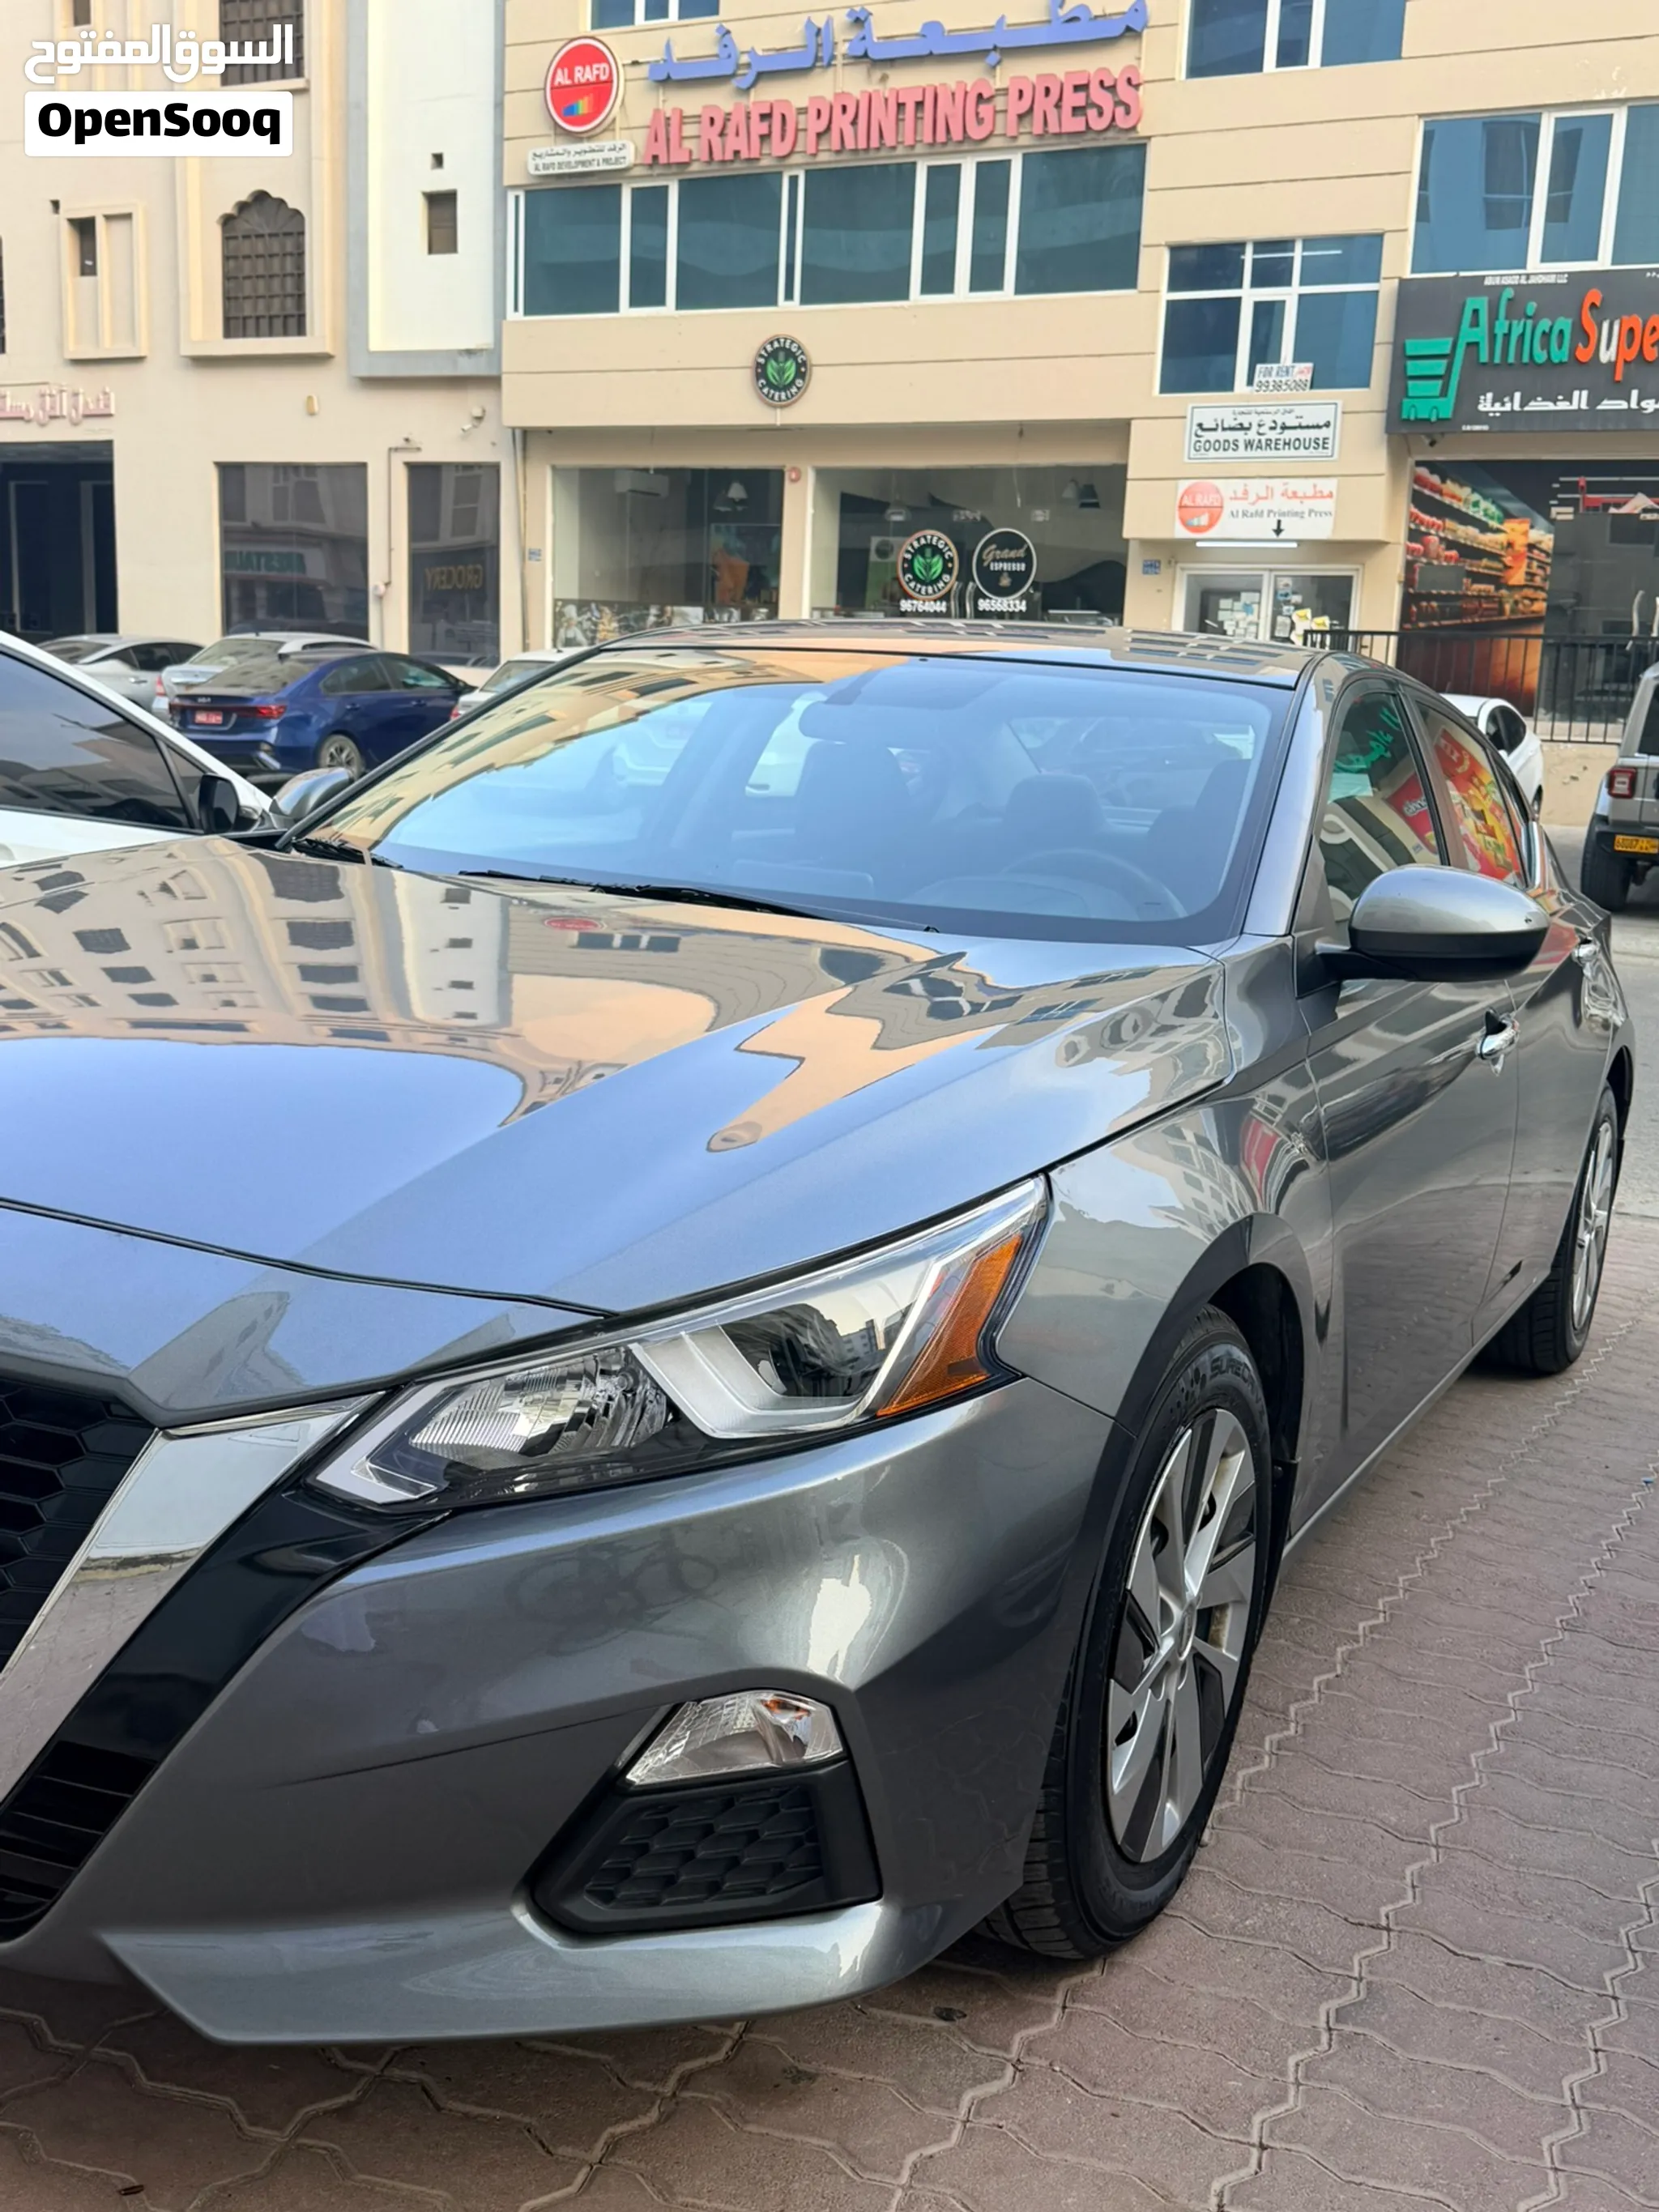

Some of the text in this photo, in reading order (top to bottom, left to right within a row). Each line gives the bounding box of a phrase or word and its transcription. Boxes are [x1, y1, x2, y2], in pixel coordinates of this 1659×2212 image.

[647, 0, 1149, 90] مطبعة الرفد
[554, 62, 610, 86] AL RAFD
[643, 64, 1144, 164] AL RAFD PRINTING PRESS
[1456, 287, 1573, 364] Africa
[756, 338, 807, 364] STRATEGIC
[1257, 364, 1295, 378] FOR RENT
[757, 378, 804, 401] CATERING
[1596, 389, 1659, 413] واد
[1193, 415, 1332, 438] مستودع بضائع
[1192, 437, 1330, 453] GOODS WAREHOUSE
[1181, 495, 1221, 507] AL RAFD
[1229, 482, 1334, 506] مطبعة الرفد
[1228, 508, 1333, 520] Al Rafd Printing Press
[903, 535, 953, 560] STRATEGIC
[982, 543, 1029, 567] Grand
[989, 561, 1026, 572] ESPRESSO
[903, 573, 951, 596] CATERING
